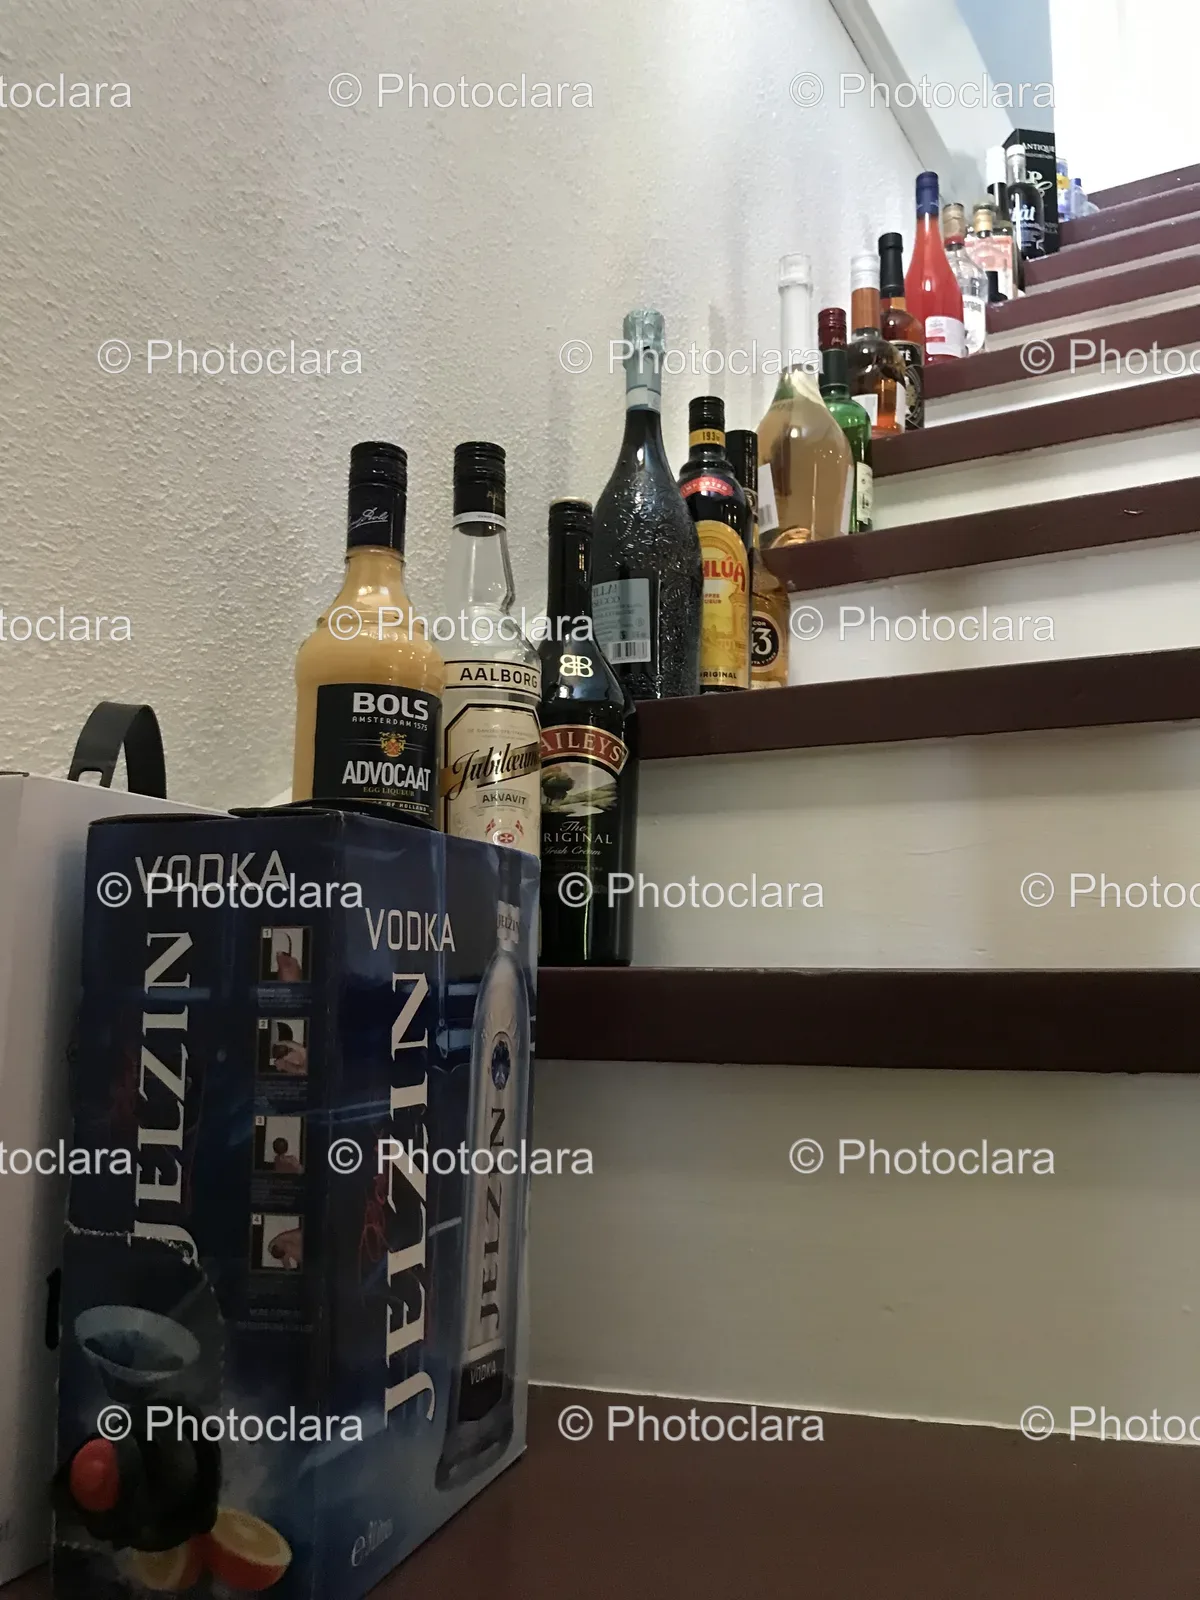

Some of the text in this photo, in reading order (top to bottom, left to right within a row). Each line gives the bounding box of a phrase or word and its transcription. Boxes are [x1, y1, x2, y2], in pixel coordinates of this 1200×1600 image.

[702, 556, 745, 592] HLÚA
[460, 667, 538, 688] AALBORG
[353, 692, 429, 721] BOLS
[352, 715, 428, 731] AMSTERDAM 1575
[541, 731, 624, 763] AILEYS
[342, 760, 431, 792] ADVOCAAT
[382, 786, 415, 797] LIQUEUR
[482, 793, 527, 805] AKVAVIT
[543, 832, 613, 845] RIGINAL
[560, 820, 587, 832] The
[135, 850, 290, 894] VODKA
[366, 908, 455, 952] VODKA
[126, 931, 198, 1267] JELZIN
[384, 971, 435, 1428] JELZIN
[479, 1107, 506, 1331] JELZIN
